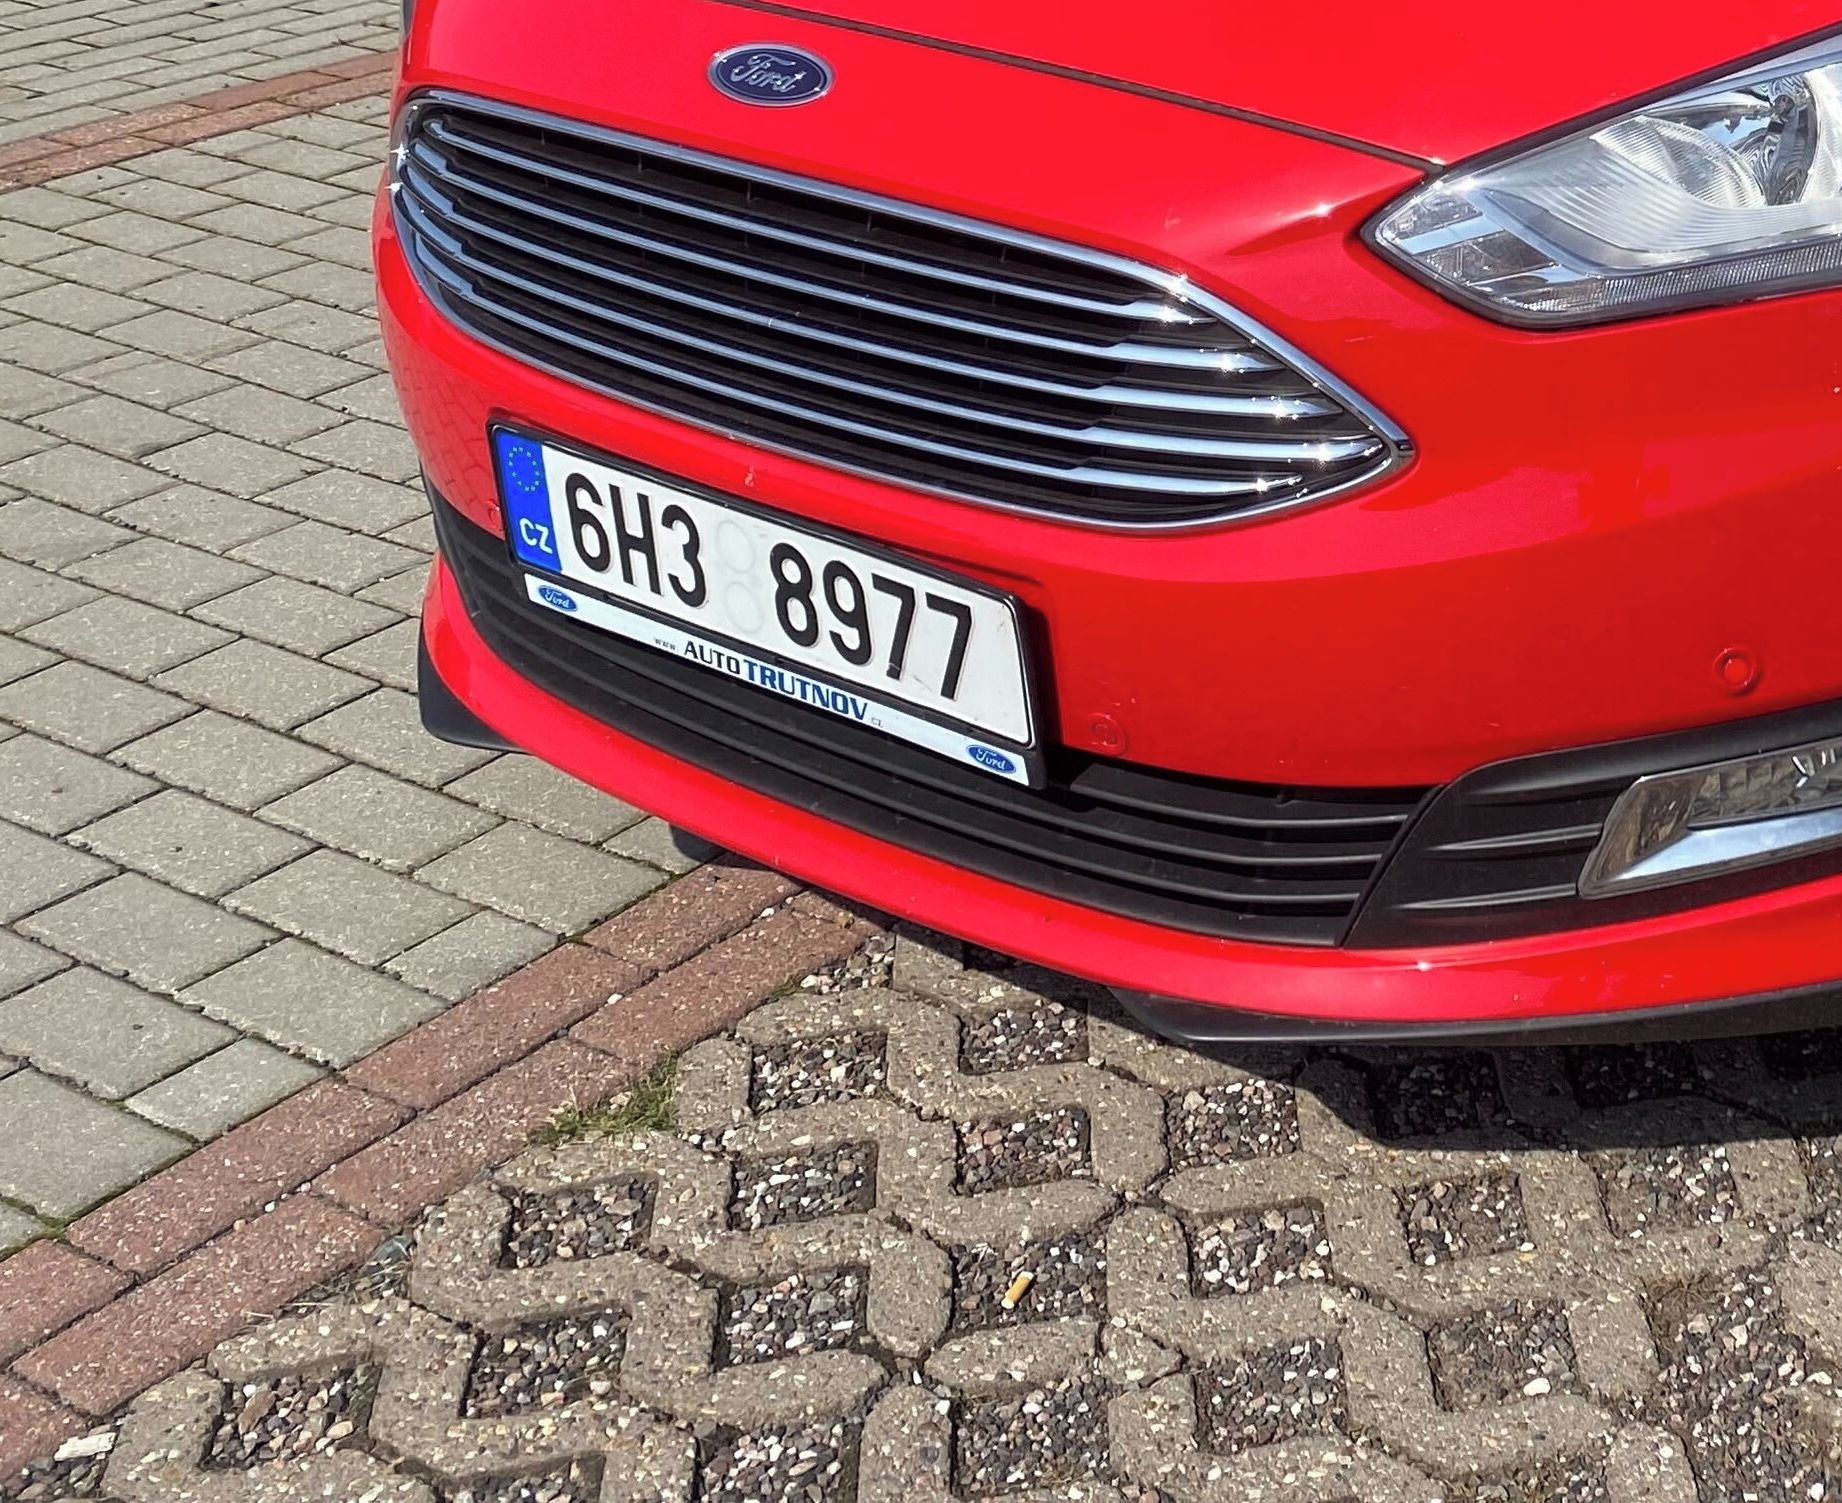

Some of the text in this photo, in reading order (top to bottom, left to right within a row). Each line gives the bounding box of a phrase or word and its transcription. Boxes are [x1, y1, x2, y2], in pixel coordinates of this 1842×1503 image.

[730, 53, 808, 93] Ford
[519, 517, 553, 554] CZ
[544, 588, 570, 609] Ford
[565, 472, 973, 701] 6H3 8977
[975, 748, 1006, 770] Ford
